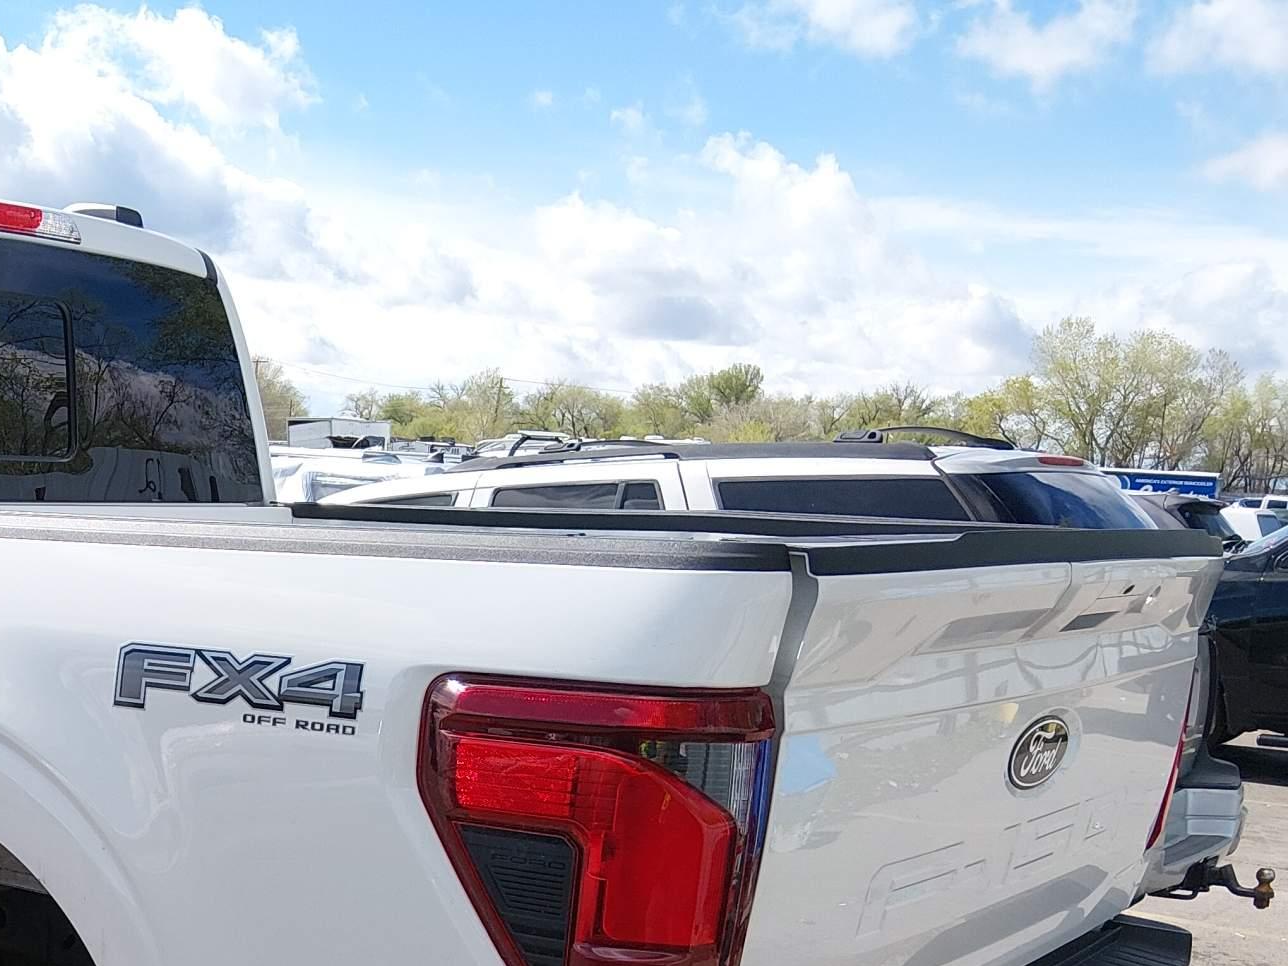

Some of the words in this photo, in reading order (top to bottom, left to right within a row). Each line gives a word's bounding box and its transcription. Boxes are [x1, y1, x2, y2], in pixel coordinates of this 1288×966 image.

[113, 642, 365, 720] FX4
[242, 713, 286, 727] OFF
[295, 718, 356, 736] ROAD
[1020, 730, 1060, 777] Ford
